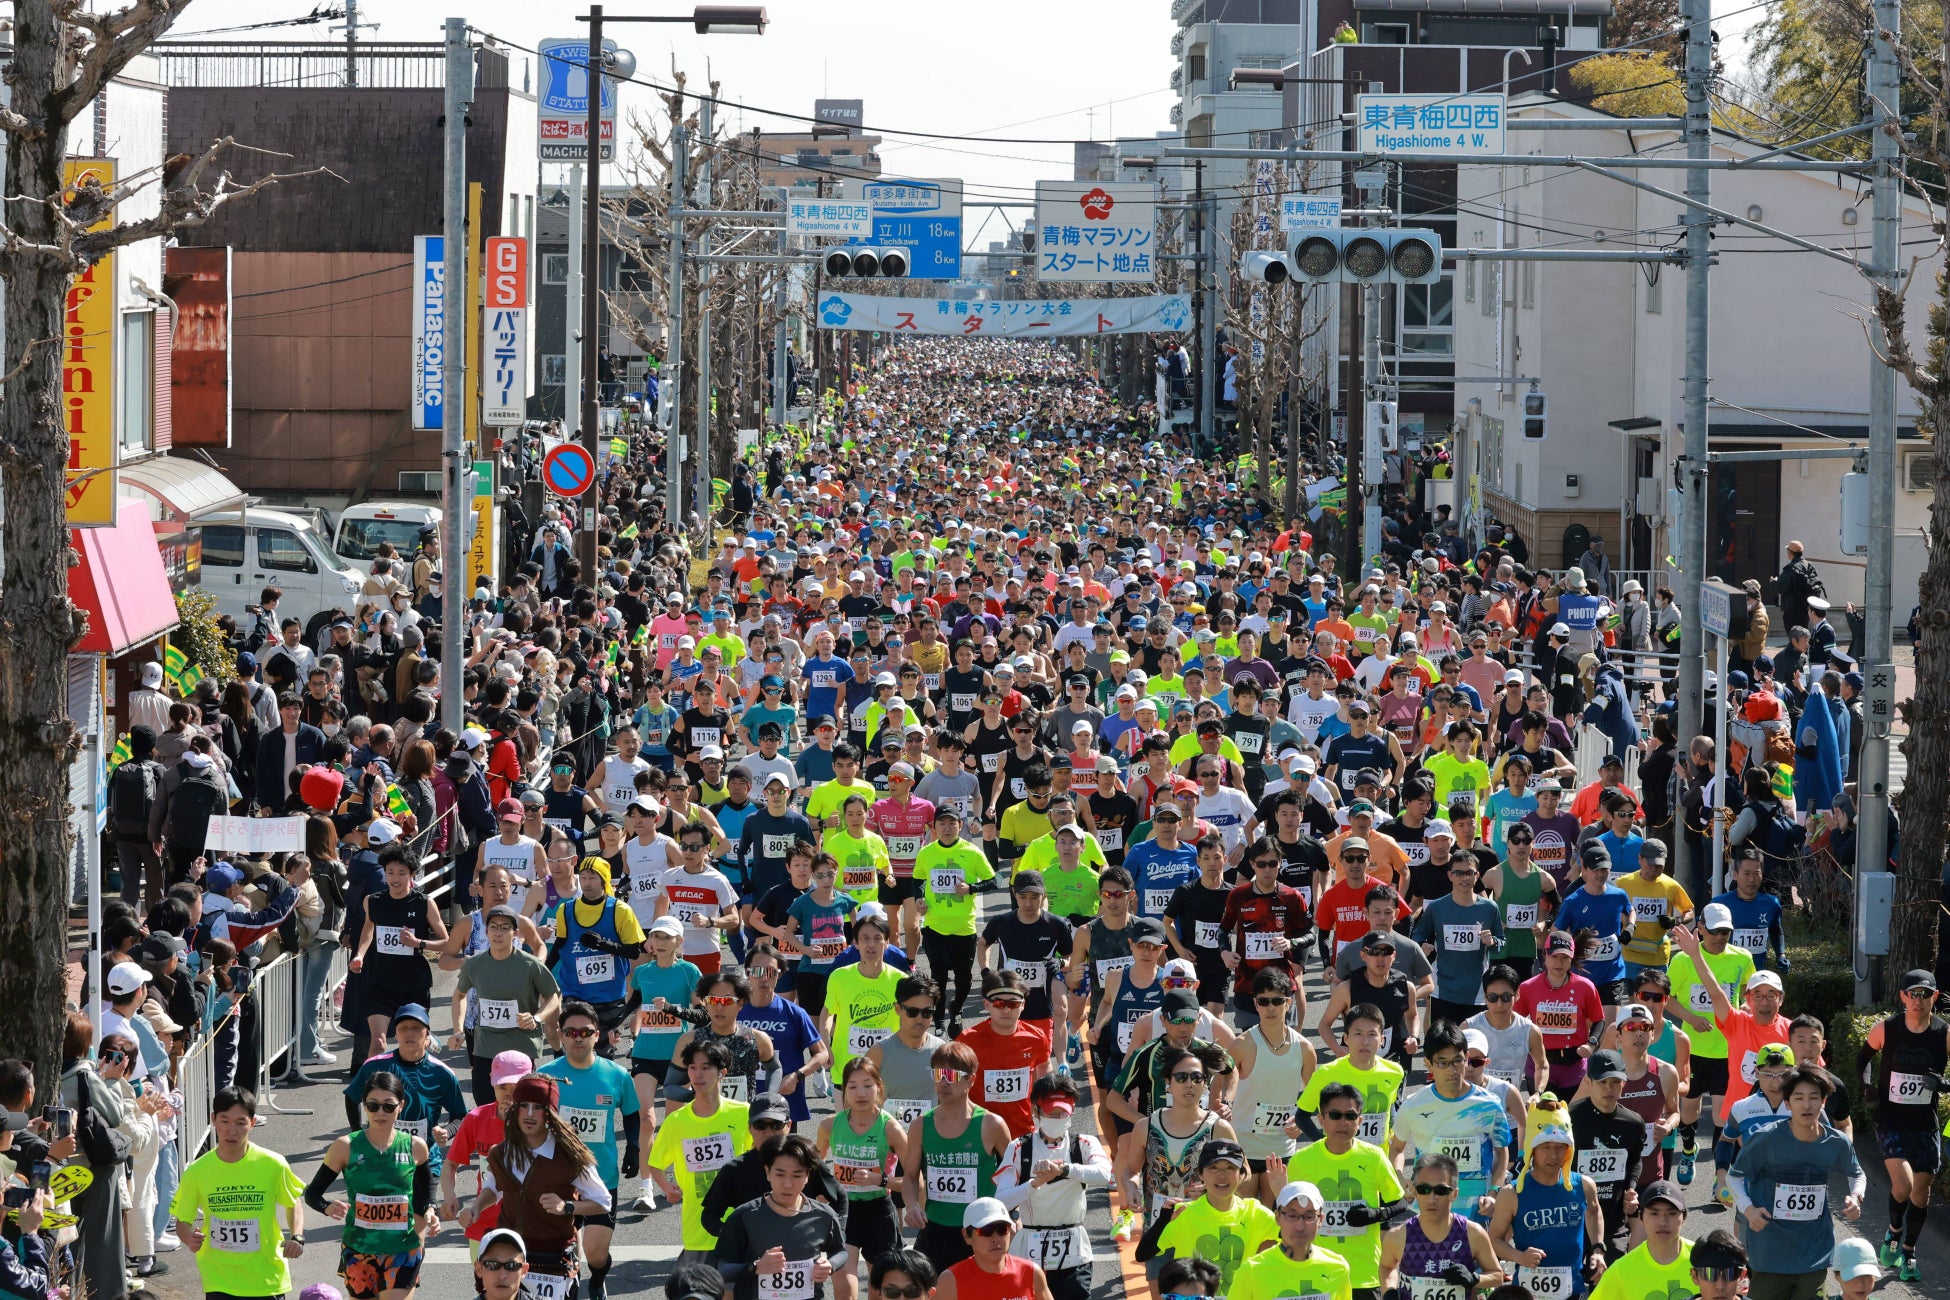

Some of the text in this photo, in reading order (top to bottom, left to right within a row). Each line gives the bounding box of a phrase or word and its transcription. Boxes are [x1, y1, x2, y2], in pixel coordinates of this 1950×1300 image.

[1363, 104, 1499, 130] 東青梅四西
[1375, 133, 1450, 150] Higashiome
[1456, 135, 1465, 147] 4
[543, 147, 581, 157] MACHI
[870, 188, 931, 199] 奥多摩街道
[790, 204, 868, 221] 東青梅四西
[1283, 200, 1339, 216] 東青梅四西
[797, 221, 840, 231] Higashiome
[843, 222, 848, 231] 4
[879, 238, 919, 246] Tachikawa
[1042, 225, 1151, 247] 青梅マラソン
[1042, 252, 1151, 273] スタート地点
[496, 243, 517, 305] GS
[937, 300, 1073, 316] 青梅マラソン大会
[425, 261, 444, 407] Panasonic
[492, 311, 520, 406] バッテリー
[416, 337, 424, 406] カーナビゲーション
[1567, 607, 1595, 620] PHOTO
[1872, 673, 1887, 715] 交通
[1242, 737, 1258, 747] 791
[769, 841, 788, 852] 803
[896, 842, 914, 853] 549
[1100, 834, 1116, 845] 797
[1538, 848, 1562, 859] 20095
[849, 872, 872, 883] 20060
[937, 875, 957, 886] 801
[1151, 896, 1168, 907] 103
[1636, 903, 1662, 915] 9691
[1515, 910, 1534, 922] 491
[1453, 931, 1474, 944] 780
[1739, 935, 1764, 948] 1162
[586, 962, 607, 976] 695
[488, 1007, 510, 1021] 574
[646, 1011, 676, 1025] 20063
[1542, 1012, 1572, 1026] 20086
[996, 1076, 1021, 1093] 831
[1899, 1081, 1924, 1097] 697
[571, 1116, 597, 1133] 805
[1266, 1111, 1289, 1127] 729
[694, 1143, 724, 1161] 852
[834, 1143, 877, 1160] さいたま市
[925, 1152, 979, 1166] さいたま市陸協
[1441, 1146, 1471, 1162] 804
[1588, 1157, 1616, 1173] 882
[215, 1185, 256, 1193] TOKYO
[936, 1176, 966, 1193] 662
[208, 1193, 264, 1204] MUSASHINOKITA
[1787, 1194, 1815, 1211] 658
[363, 1203, 402, 1221] 20054
[1325, 1209, 1346, 1226] 63
[1523, 1206, 1568, 1228] GRT
[210, 1227, 249, 1243] C 515
[760, 1271, 804, 1290] C 858
[1530, 1275, 1561, 1292] 669
